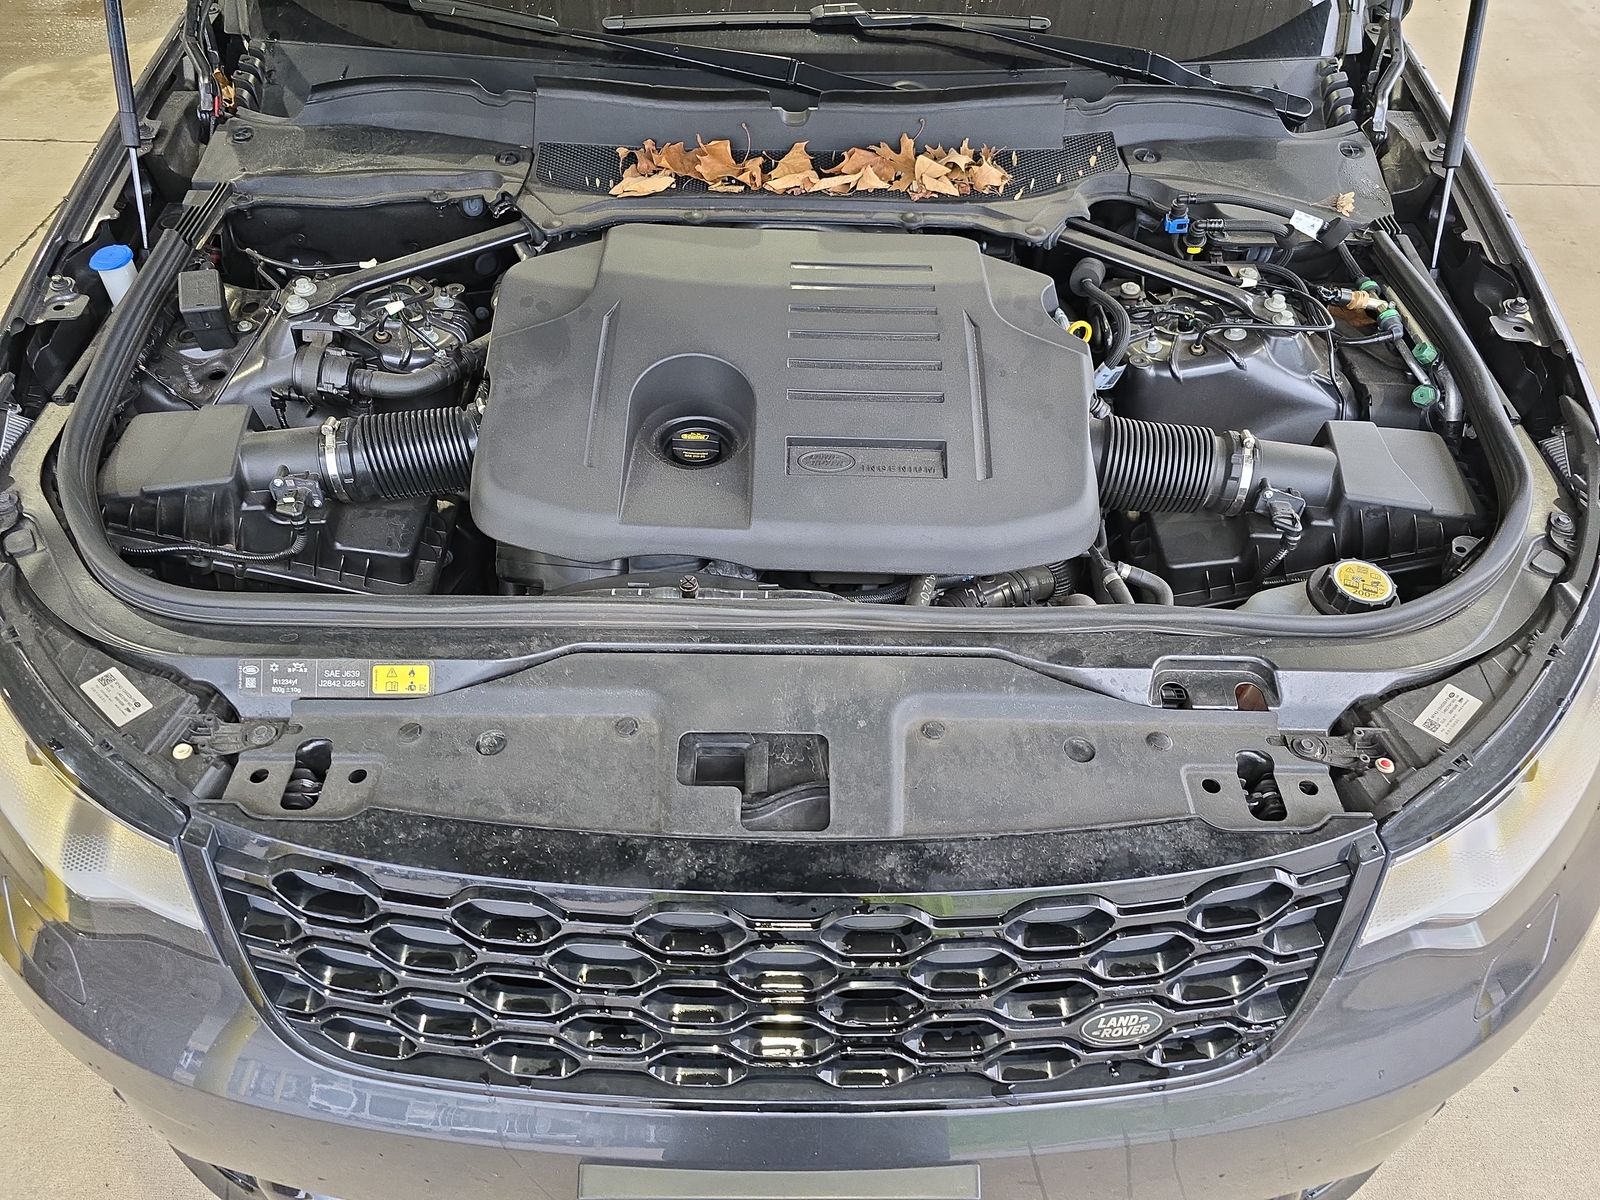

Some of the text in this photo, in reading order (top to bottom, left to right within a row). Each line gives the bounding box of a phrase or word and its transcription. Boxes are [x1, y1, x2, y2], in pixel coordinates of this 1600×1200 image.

[324, 670, 361, 678] SAE J639
[272, 678, 298, 686] R1234yf
[318, 680, 366, 688] J2842 J2845
[1097, 1014, 1139, 1028] LAND
[1100, 1023, 1151, 1038] ROVER
